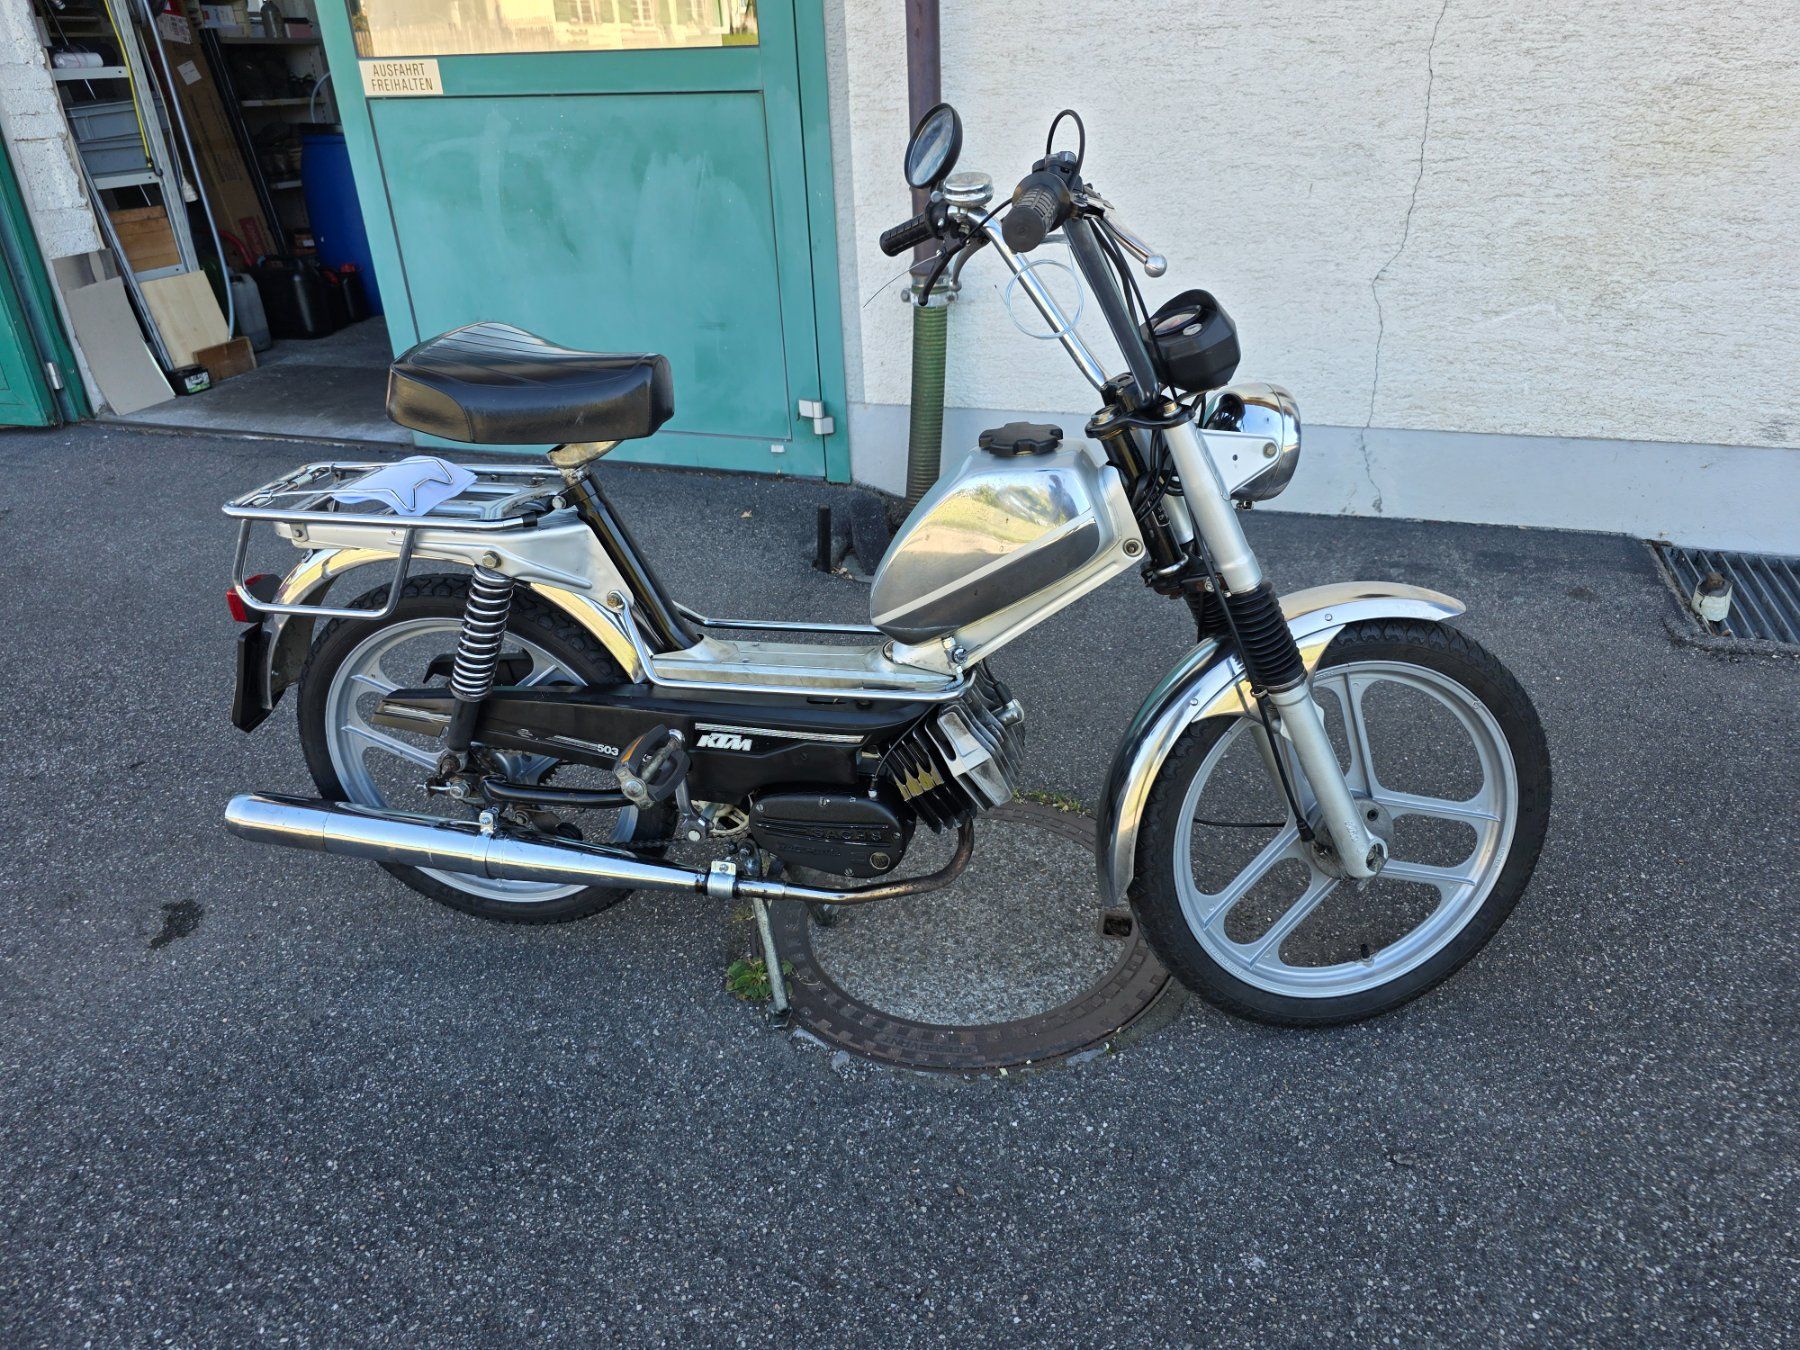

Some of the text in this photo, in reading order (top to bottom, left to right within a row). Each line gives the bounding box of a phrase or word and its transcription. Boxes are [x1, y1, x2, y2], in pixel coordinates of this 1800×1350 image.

[373, 63, 425, 77] AUSFAHRT
[371, 78, 433, 92] FREIHALTEN
[696, 732, 753, 752] KTM
[597, 743, 619, 757] 503
